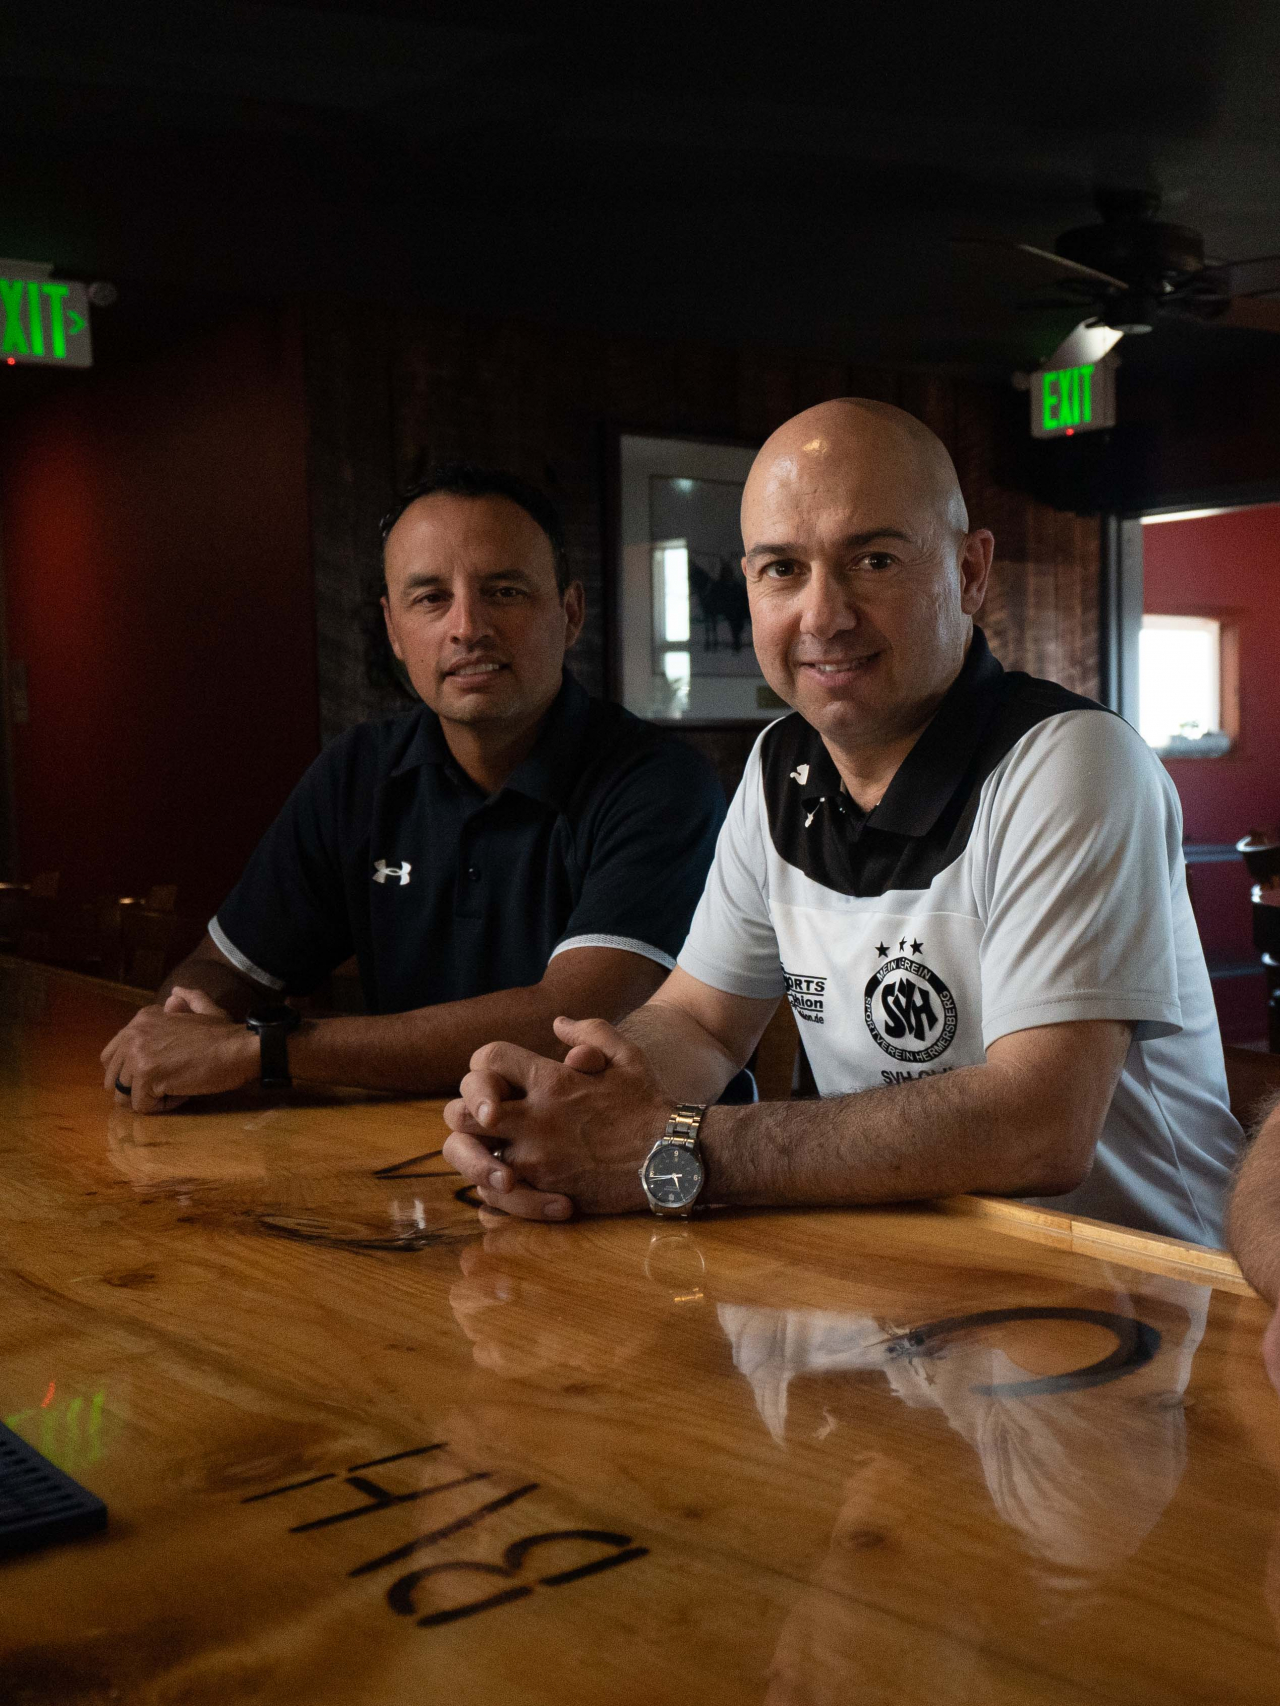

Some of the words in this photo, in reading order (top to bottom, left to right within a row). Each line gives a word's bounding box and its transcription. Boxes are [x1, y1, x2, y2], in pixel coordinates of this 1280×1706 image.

[0, 277, 69, 358] XIT
[1043, 364, 1094, 430] EXIT
[783, 975, 825, 993] ORTS
[876, 960, 897, 982] MEIN
[791, 993, 823, 1009] hion
[914, 989, 956, 1061] HERMERSBERG
